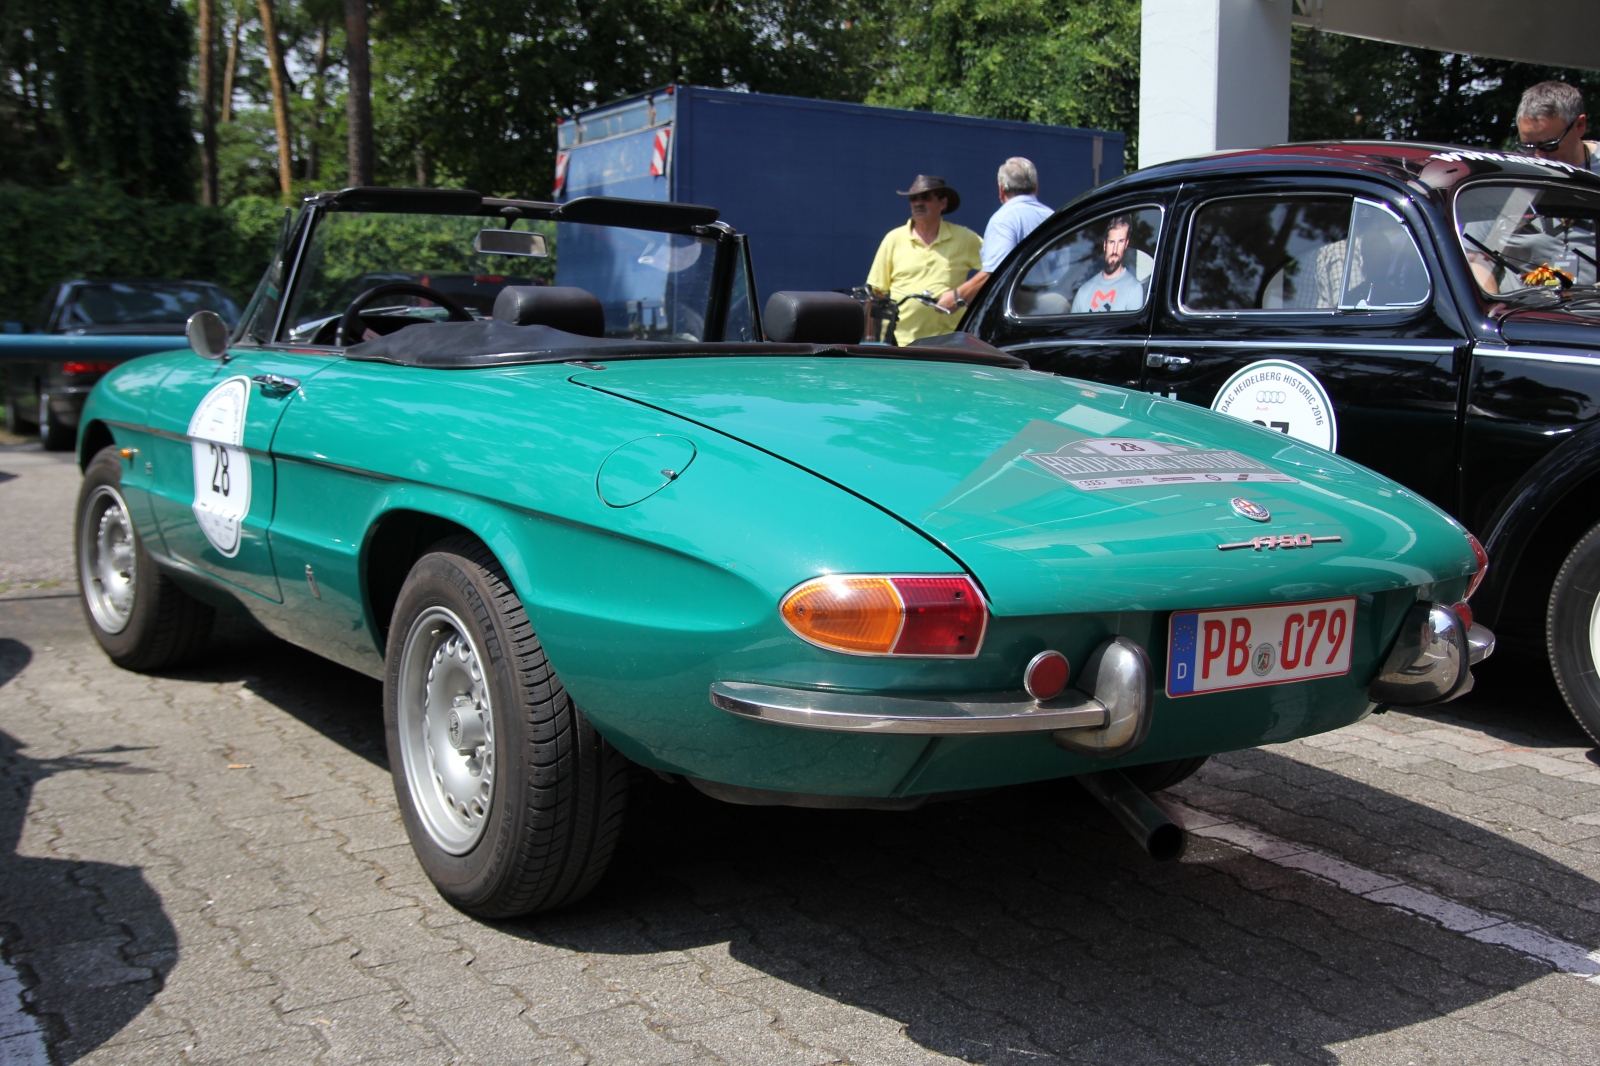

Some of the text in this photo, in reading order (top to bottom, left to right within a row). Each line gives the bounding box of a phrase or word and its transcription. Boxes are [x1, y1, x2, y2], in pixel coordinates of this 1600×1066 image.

[1221, 372, 1324, 426] DAC HEIDELBERG HISTORIC 2016
[1033, 454, 1182, 476] HEIDELBERG
[1165, 450, 1266, 470] HISTORIC
[1109, 442, 1146, 452] 28
[208, 442, 230, 497] 28
[1250, 533, 1312, 550] 1750
[449, 566, 503, 661] MICHELIN
[1202, 608, 1347, 679] PB 079
[1177, 662, 1188, 680] D
